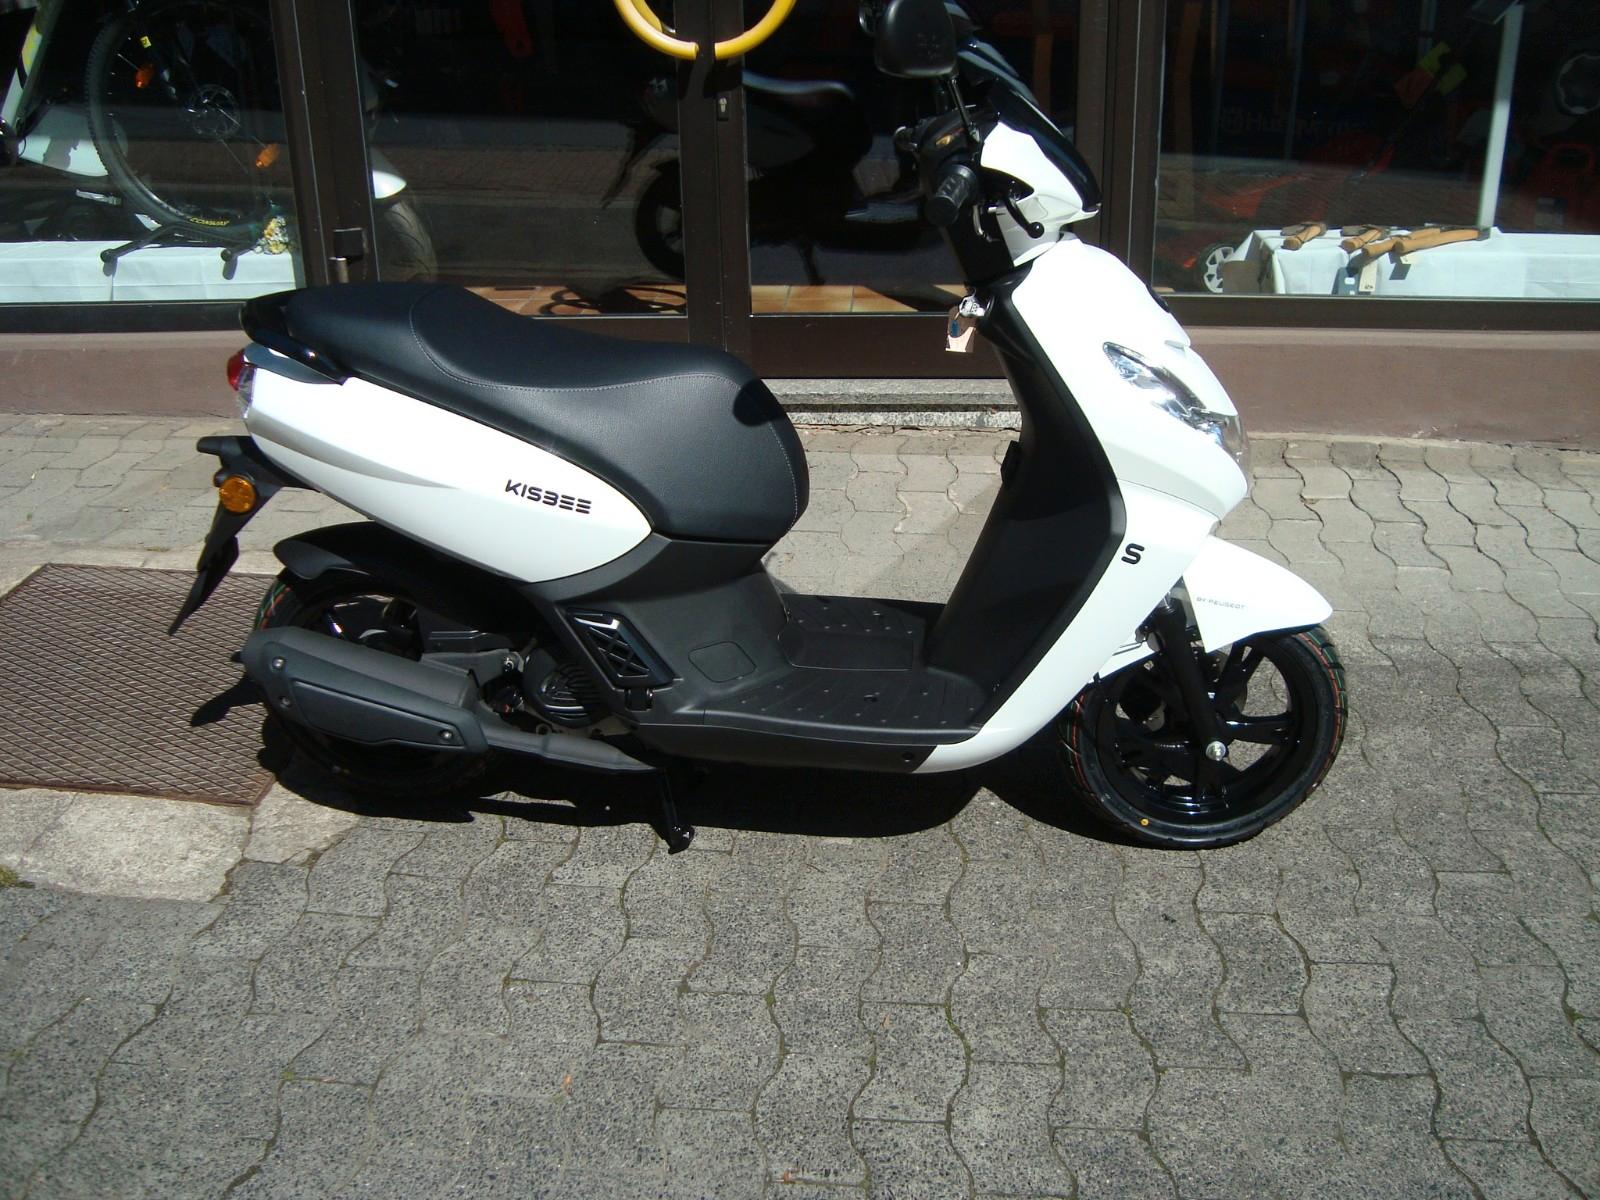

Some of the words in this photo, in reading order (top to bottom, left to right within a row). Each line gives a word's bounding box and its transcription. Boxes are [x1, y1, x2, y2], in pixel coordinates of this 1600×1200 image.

[505, 479, 592, 514] KISBEE
[1121, 543, 1145, 565] S
[1208, 598, 1246, 610] PEUGEOT
